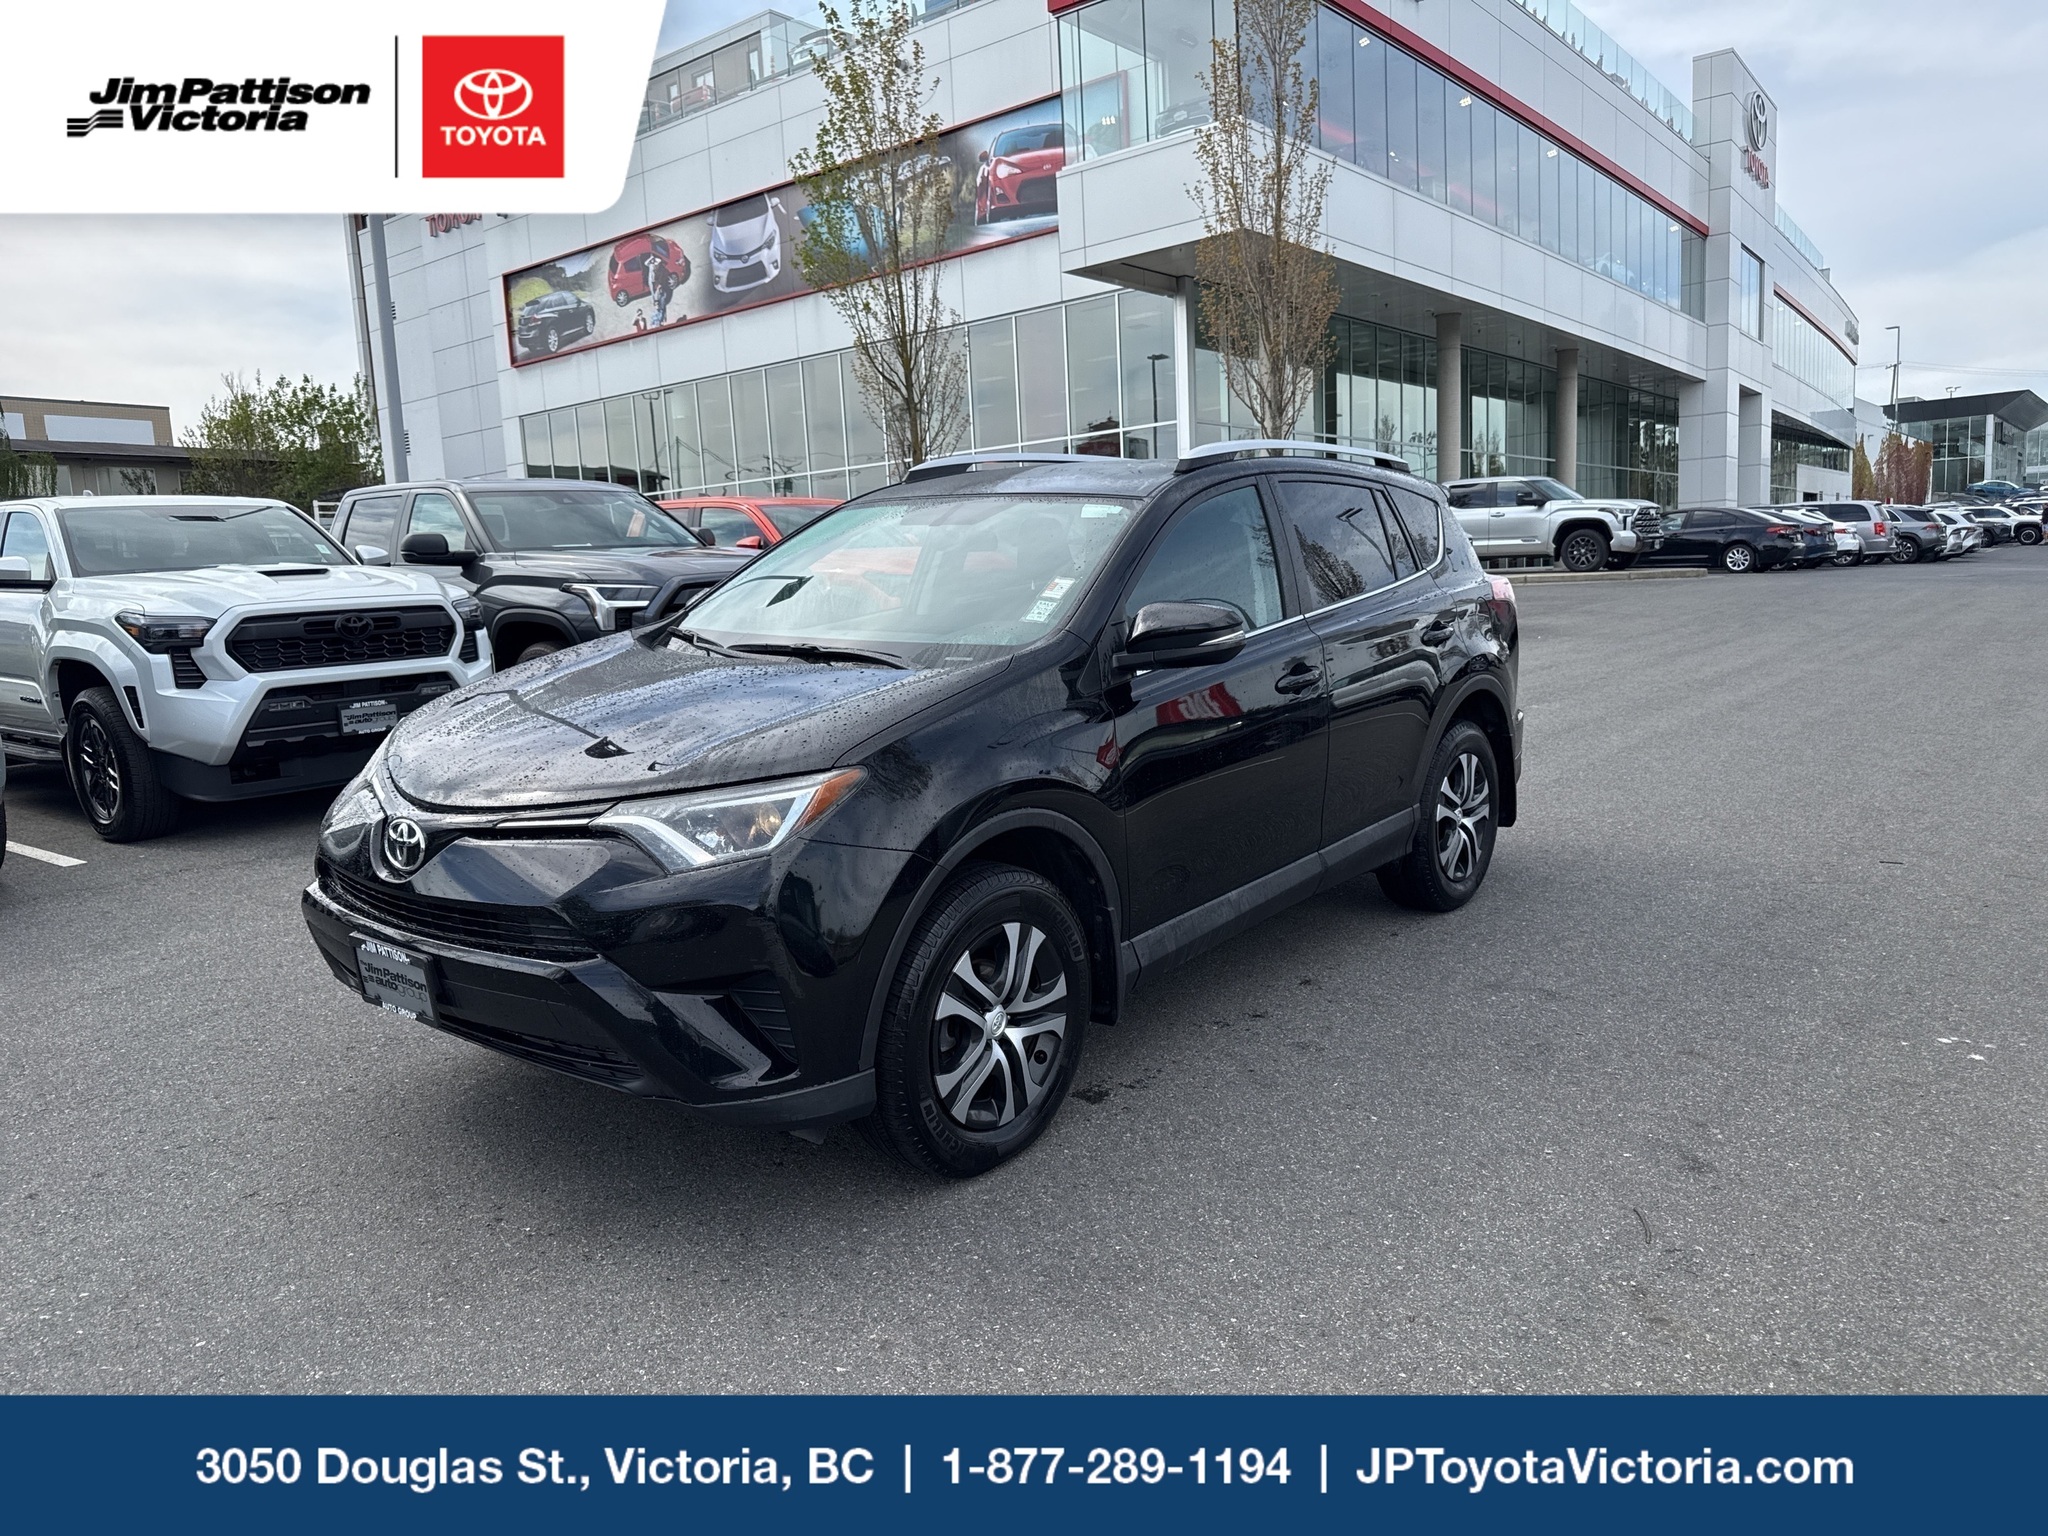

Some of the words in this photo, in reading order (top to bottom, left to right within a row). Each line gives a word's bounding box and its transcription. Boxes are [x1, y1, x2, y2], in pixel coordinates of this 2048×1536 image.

[366, 941, 377, 954] JIM
[376, 944, 408, 963] PATTISON
[382, 1001, 397, 1013] AUTO
[397, 1006, 417, 1020] GROUP
